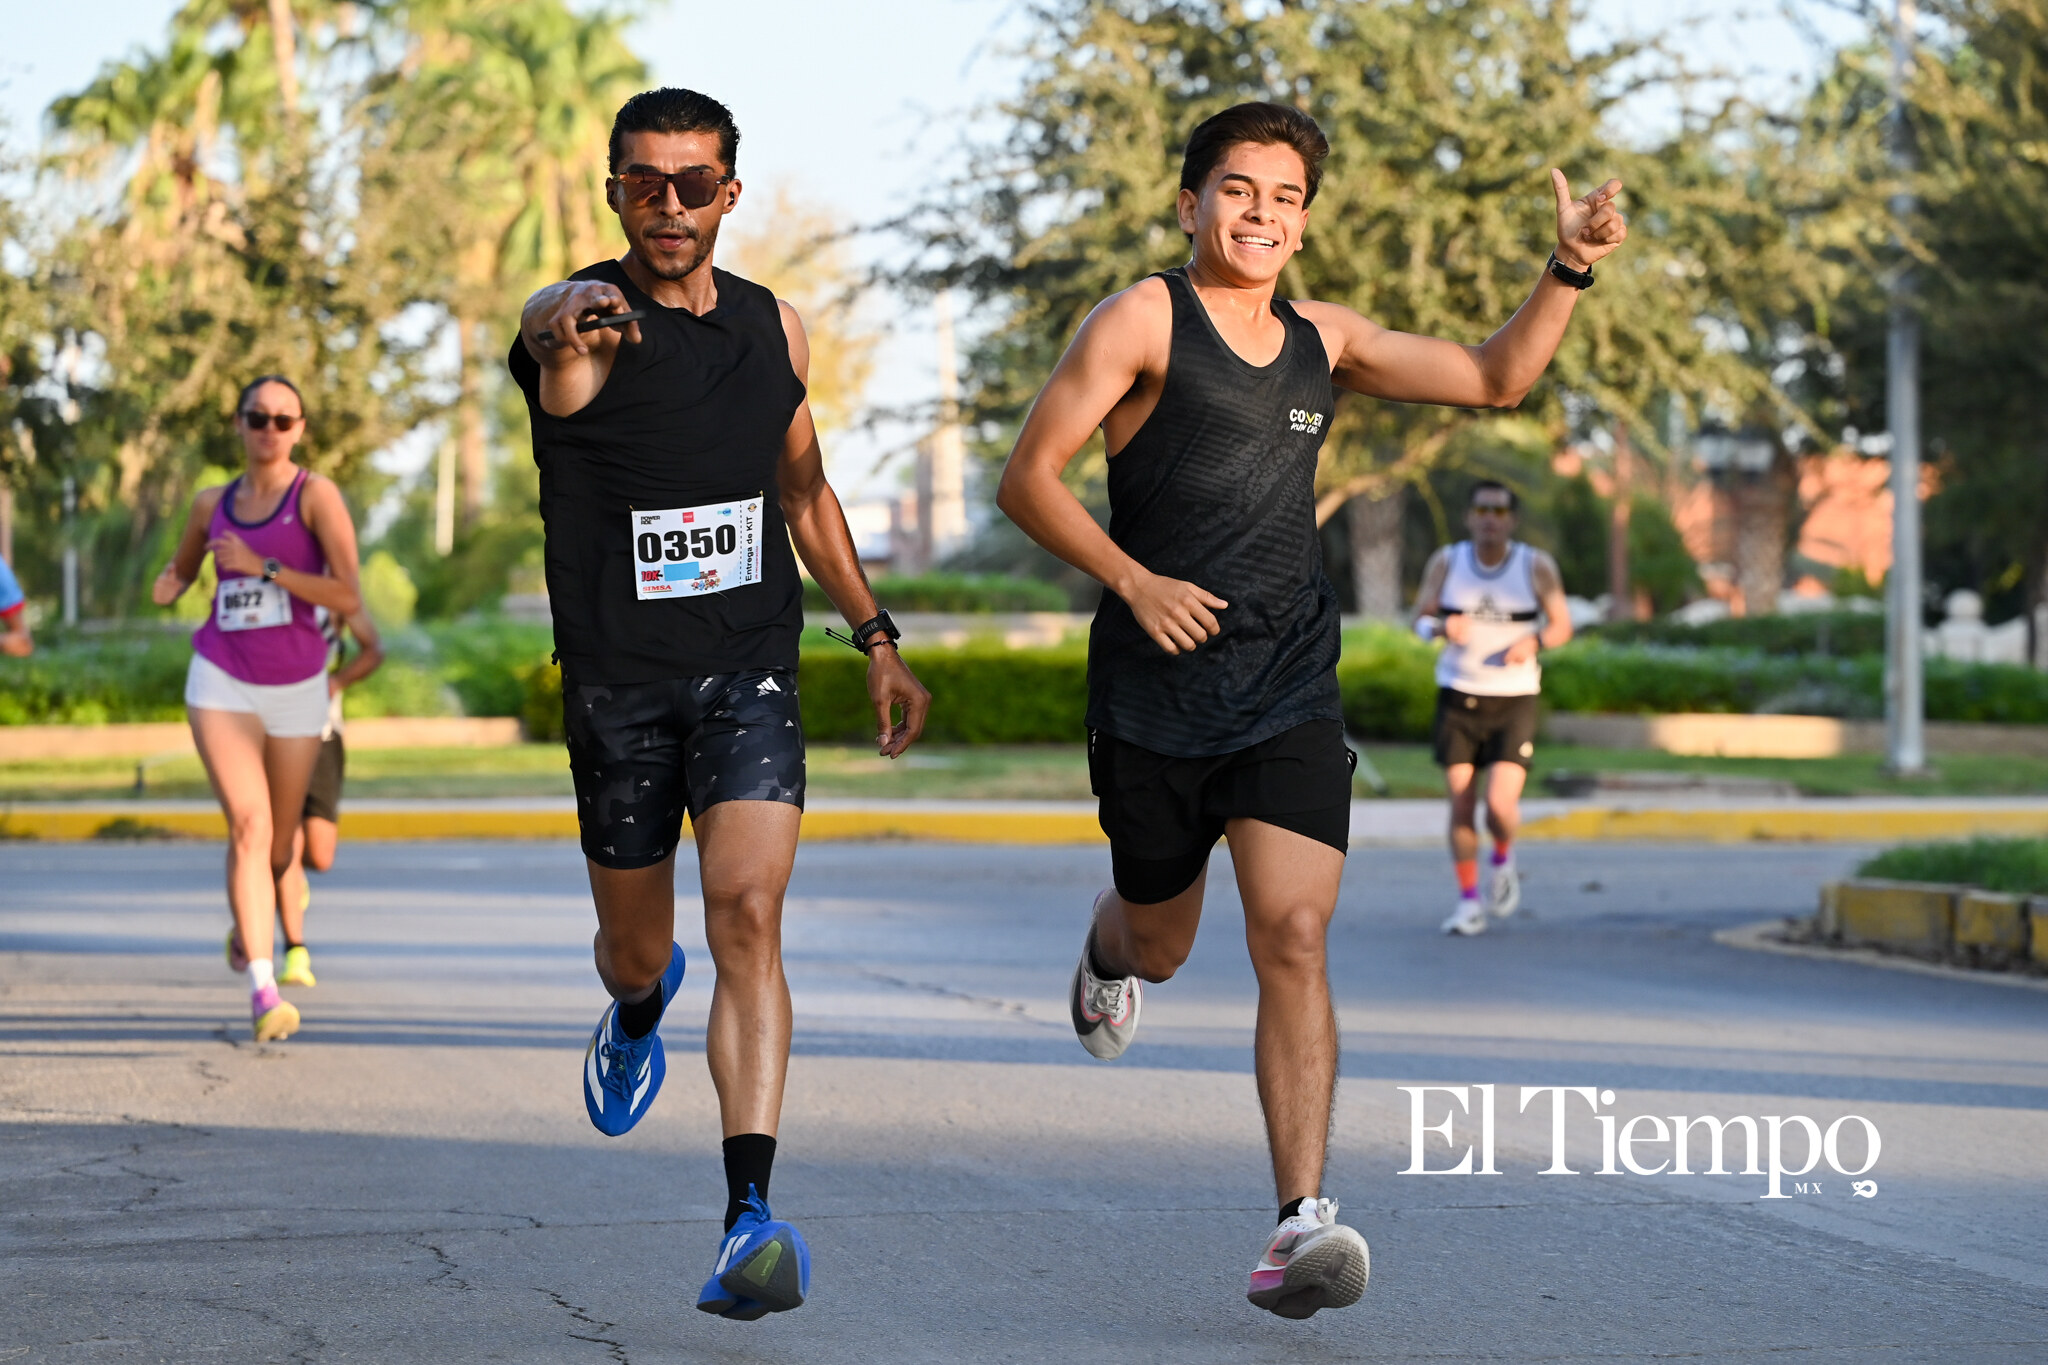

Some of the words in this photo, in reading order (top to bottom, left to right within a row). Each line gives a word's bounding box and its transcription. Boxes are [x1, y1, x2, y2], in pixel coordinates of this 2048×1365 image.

[637, 524, 736, 563] 0350
[746, 533, 753, 544] de
[745, 546, 754, 581] Entrega
[641, 570, 660, 582] 10K
